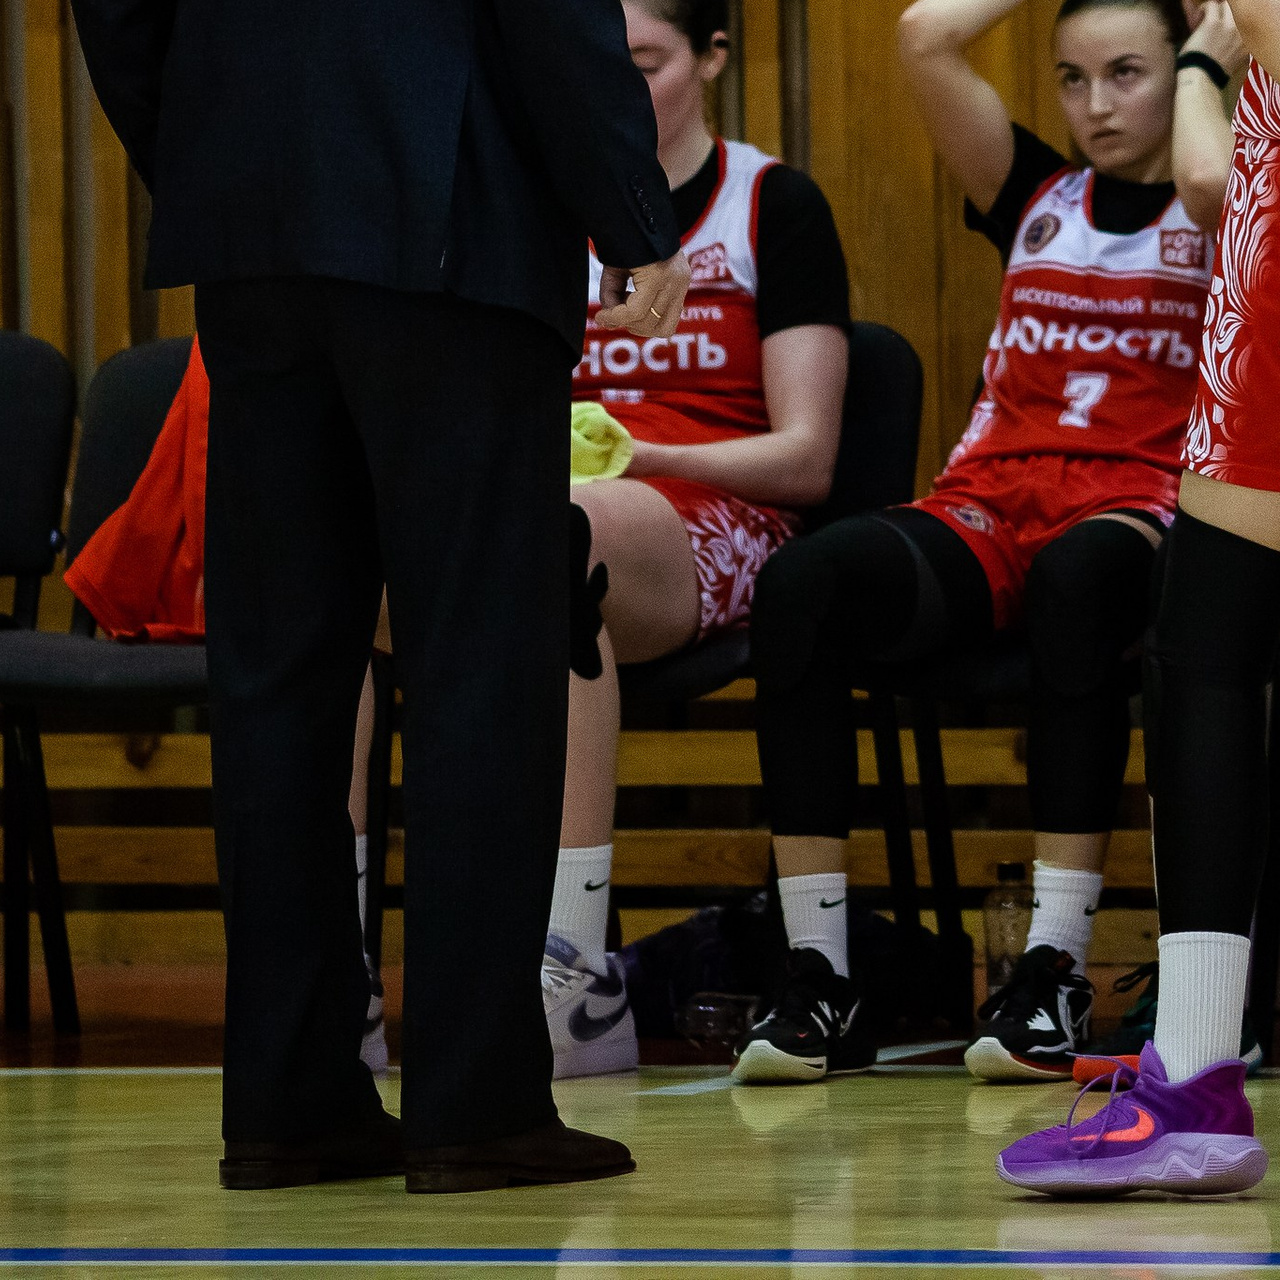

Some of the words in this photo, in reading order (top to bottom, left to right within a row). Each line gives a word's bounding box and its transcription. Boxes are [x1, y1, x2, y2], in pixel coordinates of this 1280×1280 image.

[572, 332, 728, 379] НОСТЬ
[1003, 315, 1195, 369] ЮНОСТЬ
[1058, 370, 1110, 428] 7
